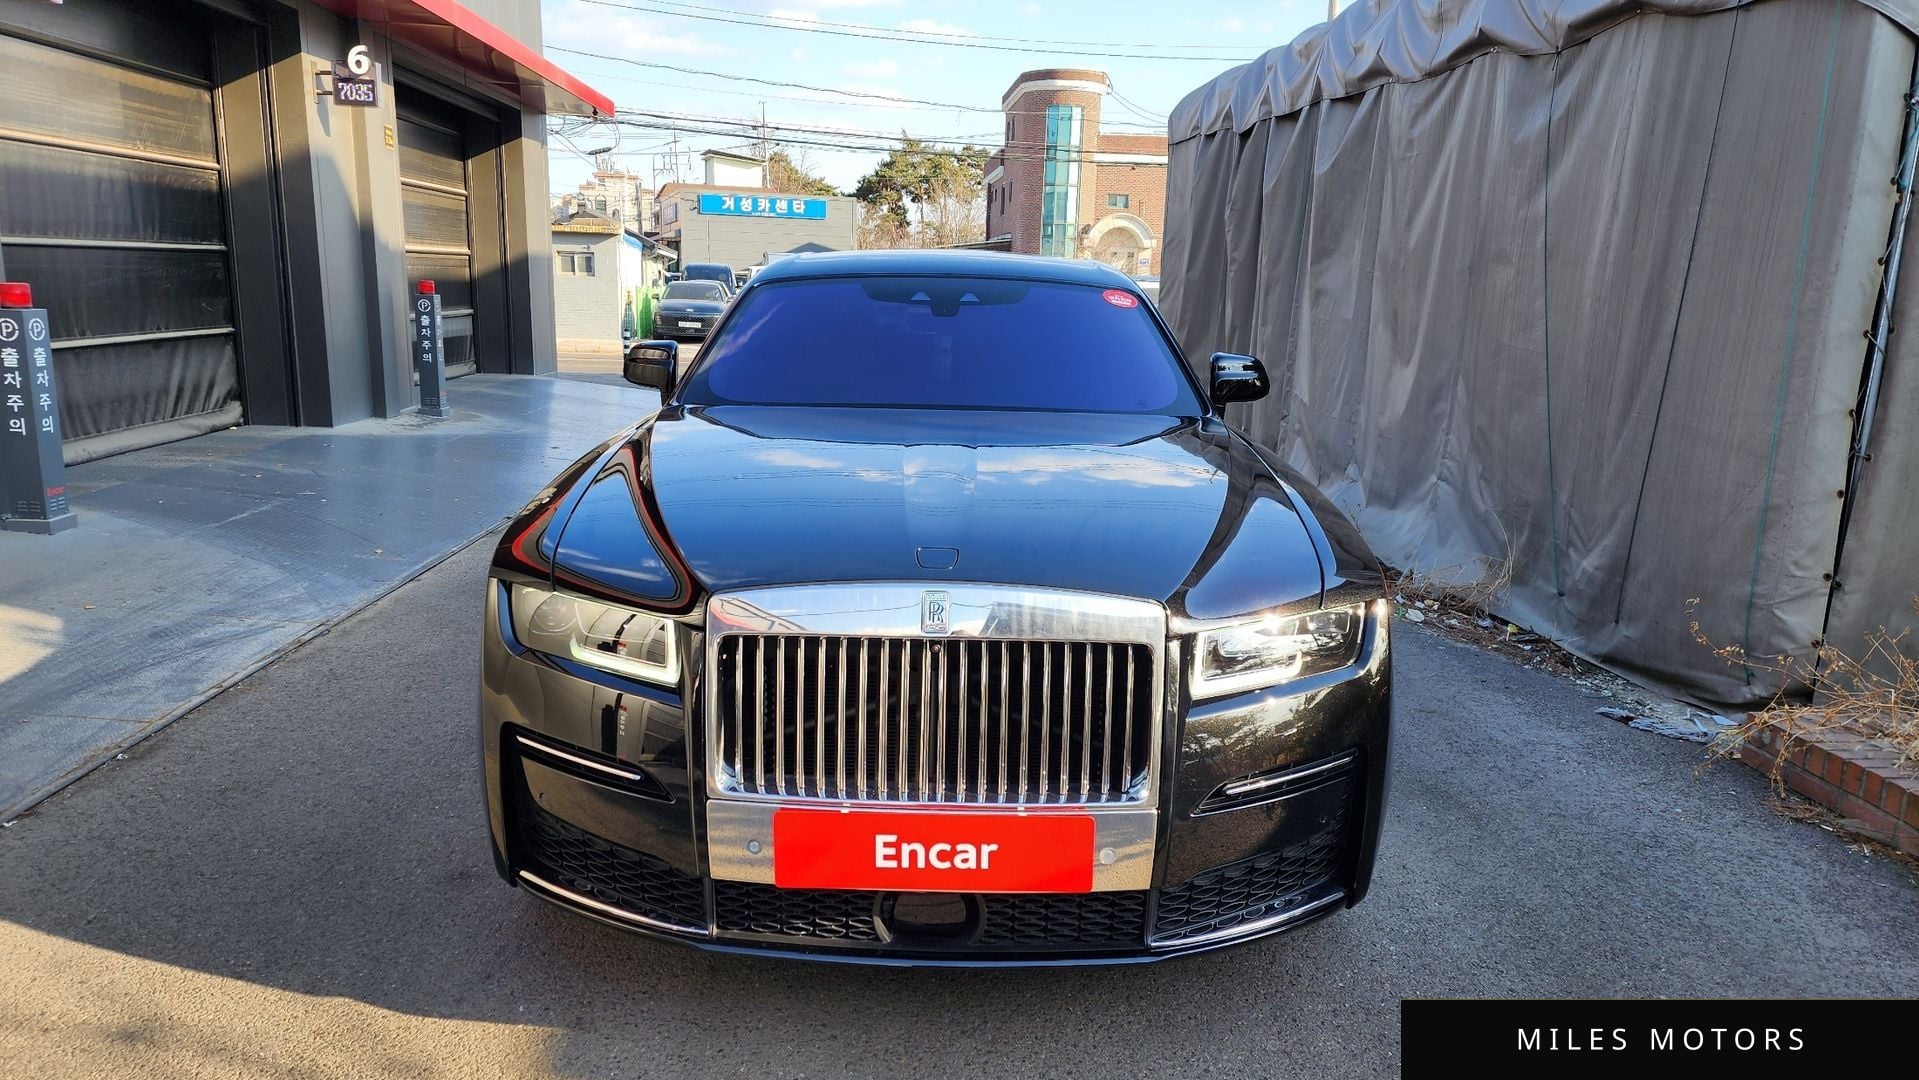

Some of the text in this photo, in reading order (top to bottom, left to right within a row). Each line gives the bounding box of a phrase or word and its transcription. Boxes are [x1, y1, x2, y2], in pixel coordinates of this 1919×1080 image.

[347, 44, 371, 75] 6
[337, 82, 374, 102] 7035
[721, 195, 806, 215] 거성카센타
[420, 314, 432, 363] 출차주의
[0, 347, 27, 436] 출차주의
[33, 346, 54, 434] 출차주의
[874, 833, 1000, 871] Encar
